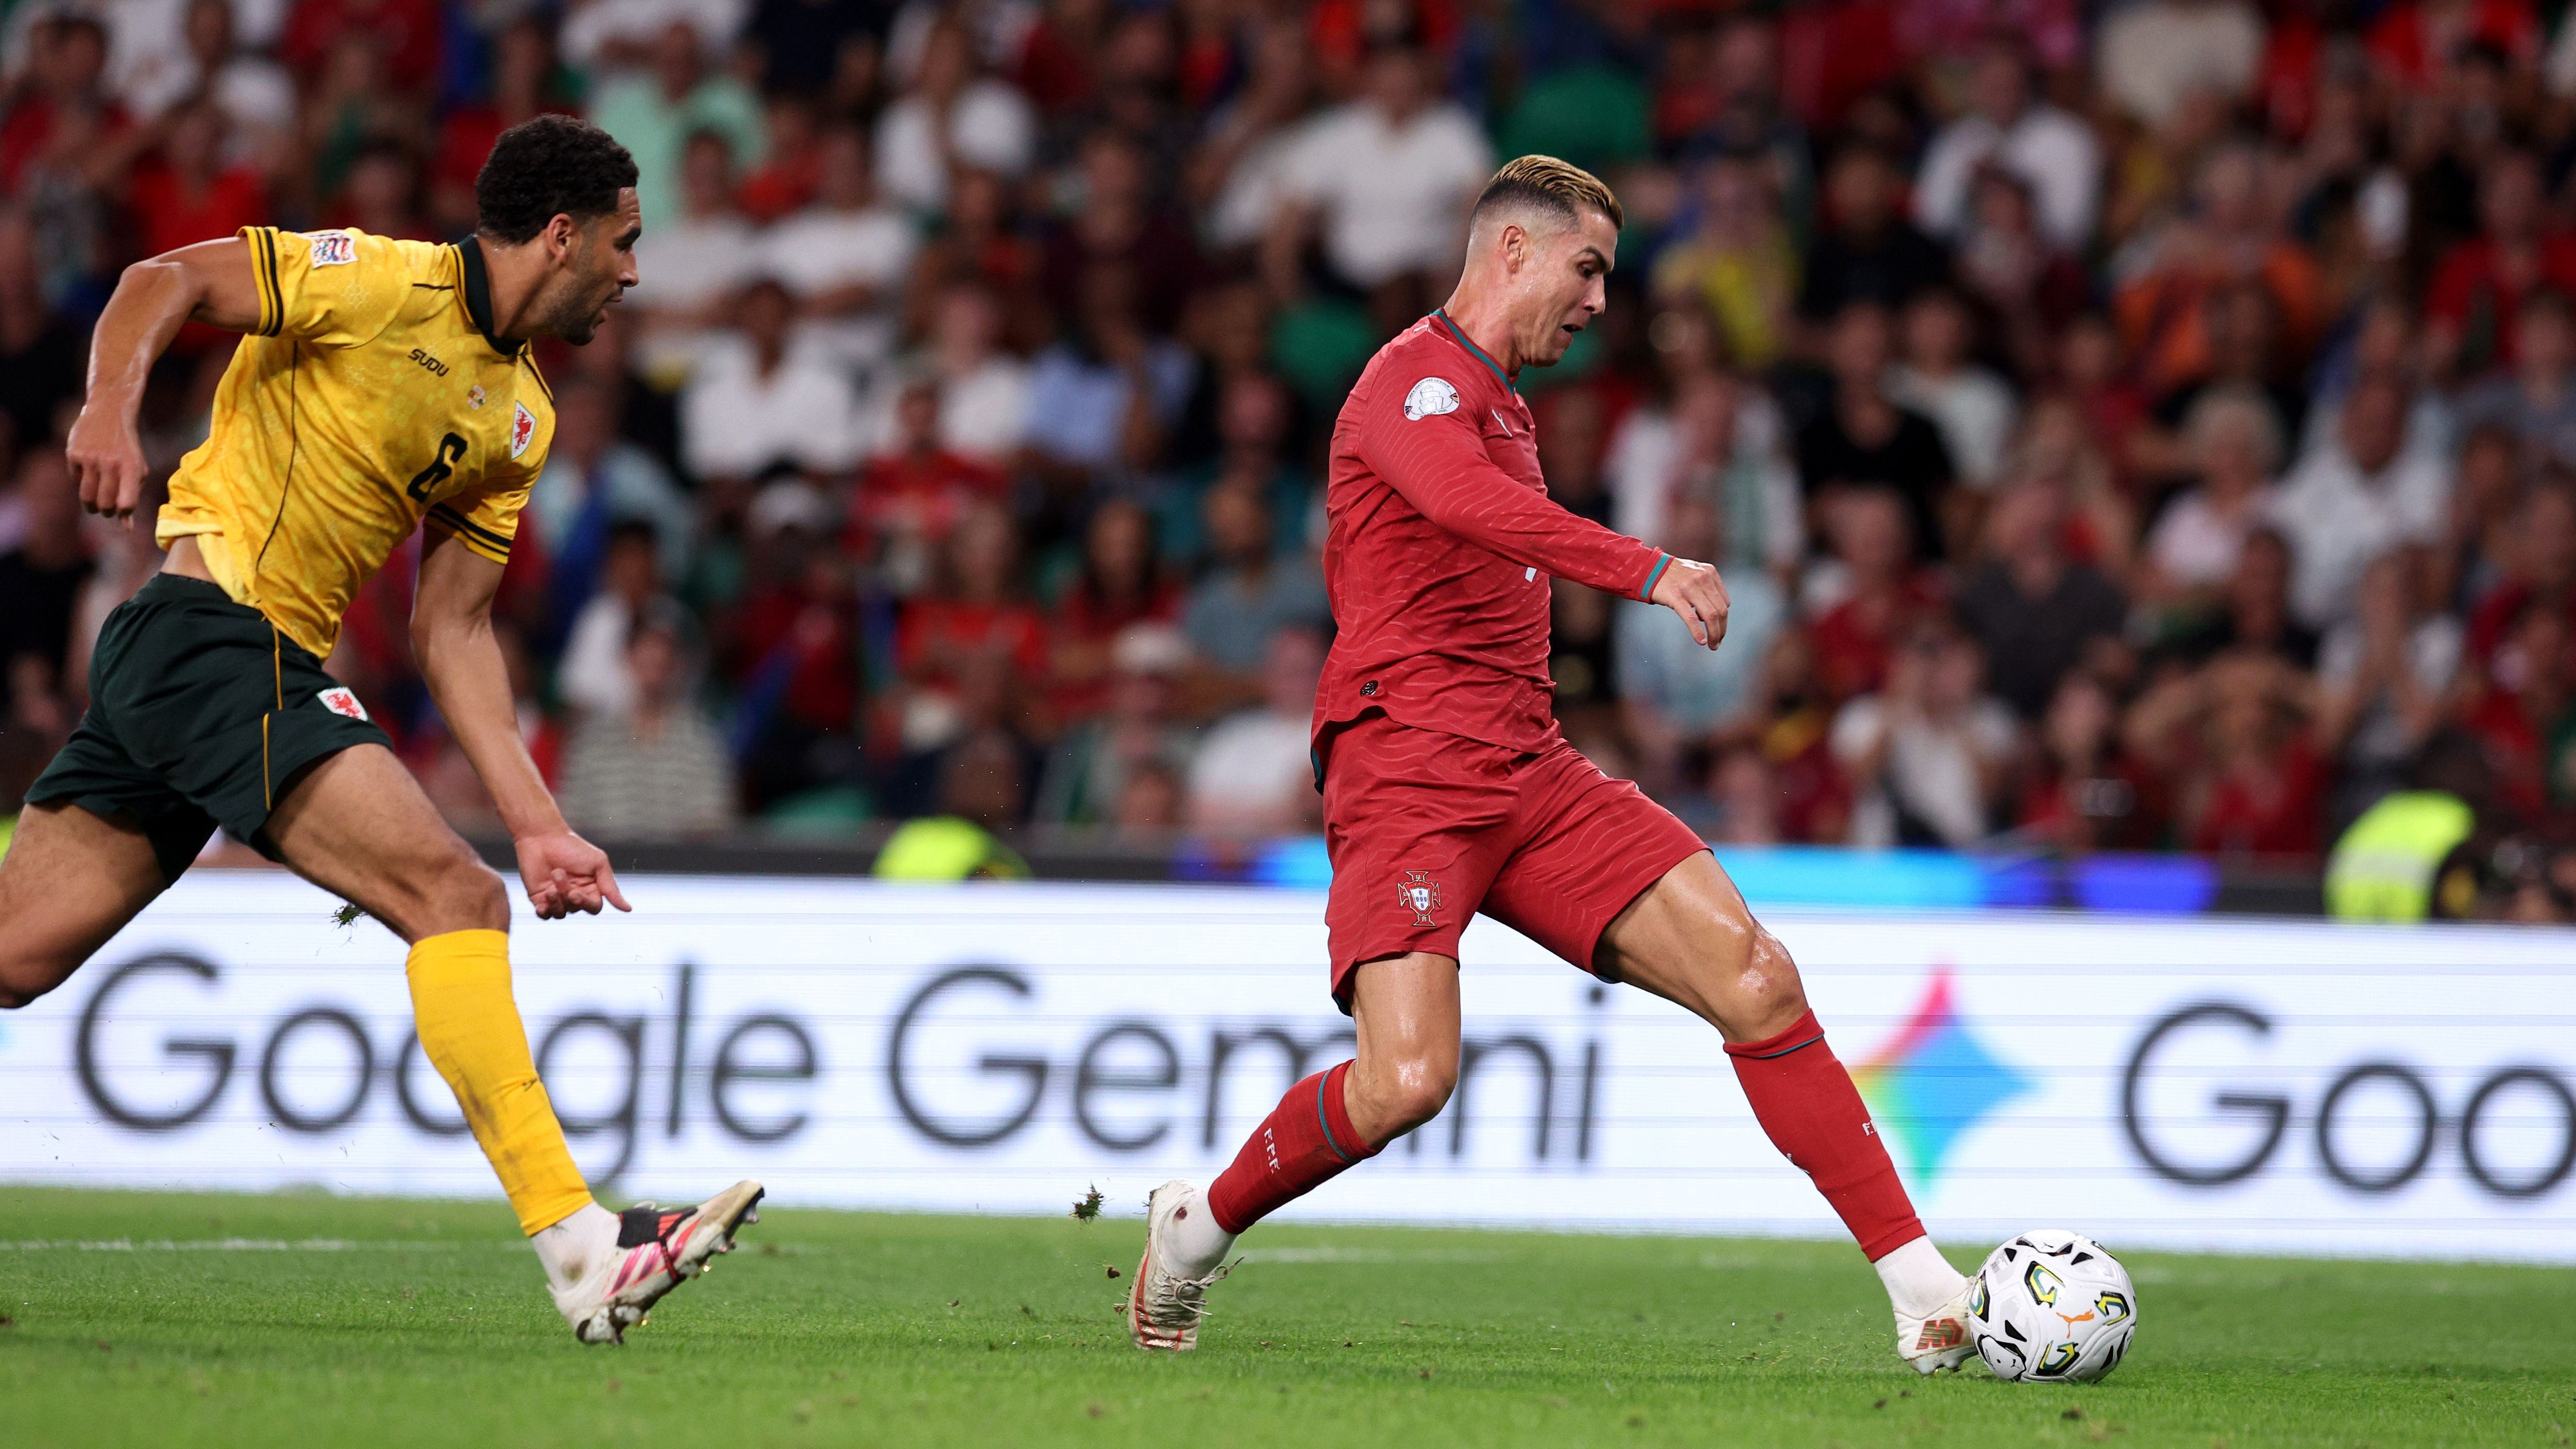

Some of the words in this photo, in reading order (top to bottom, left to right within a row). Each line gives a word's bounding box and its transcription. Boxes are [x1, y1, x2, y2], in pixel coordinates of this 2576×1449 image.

[408, 348, 450, 377] SUDU
[407, 432, 468, 502] 6
[887, 965, 1606, 1159] Gemni
